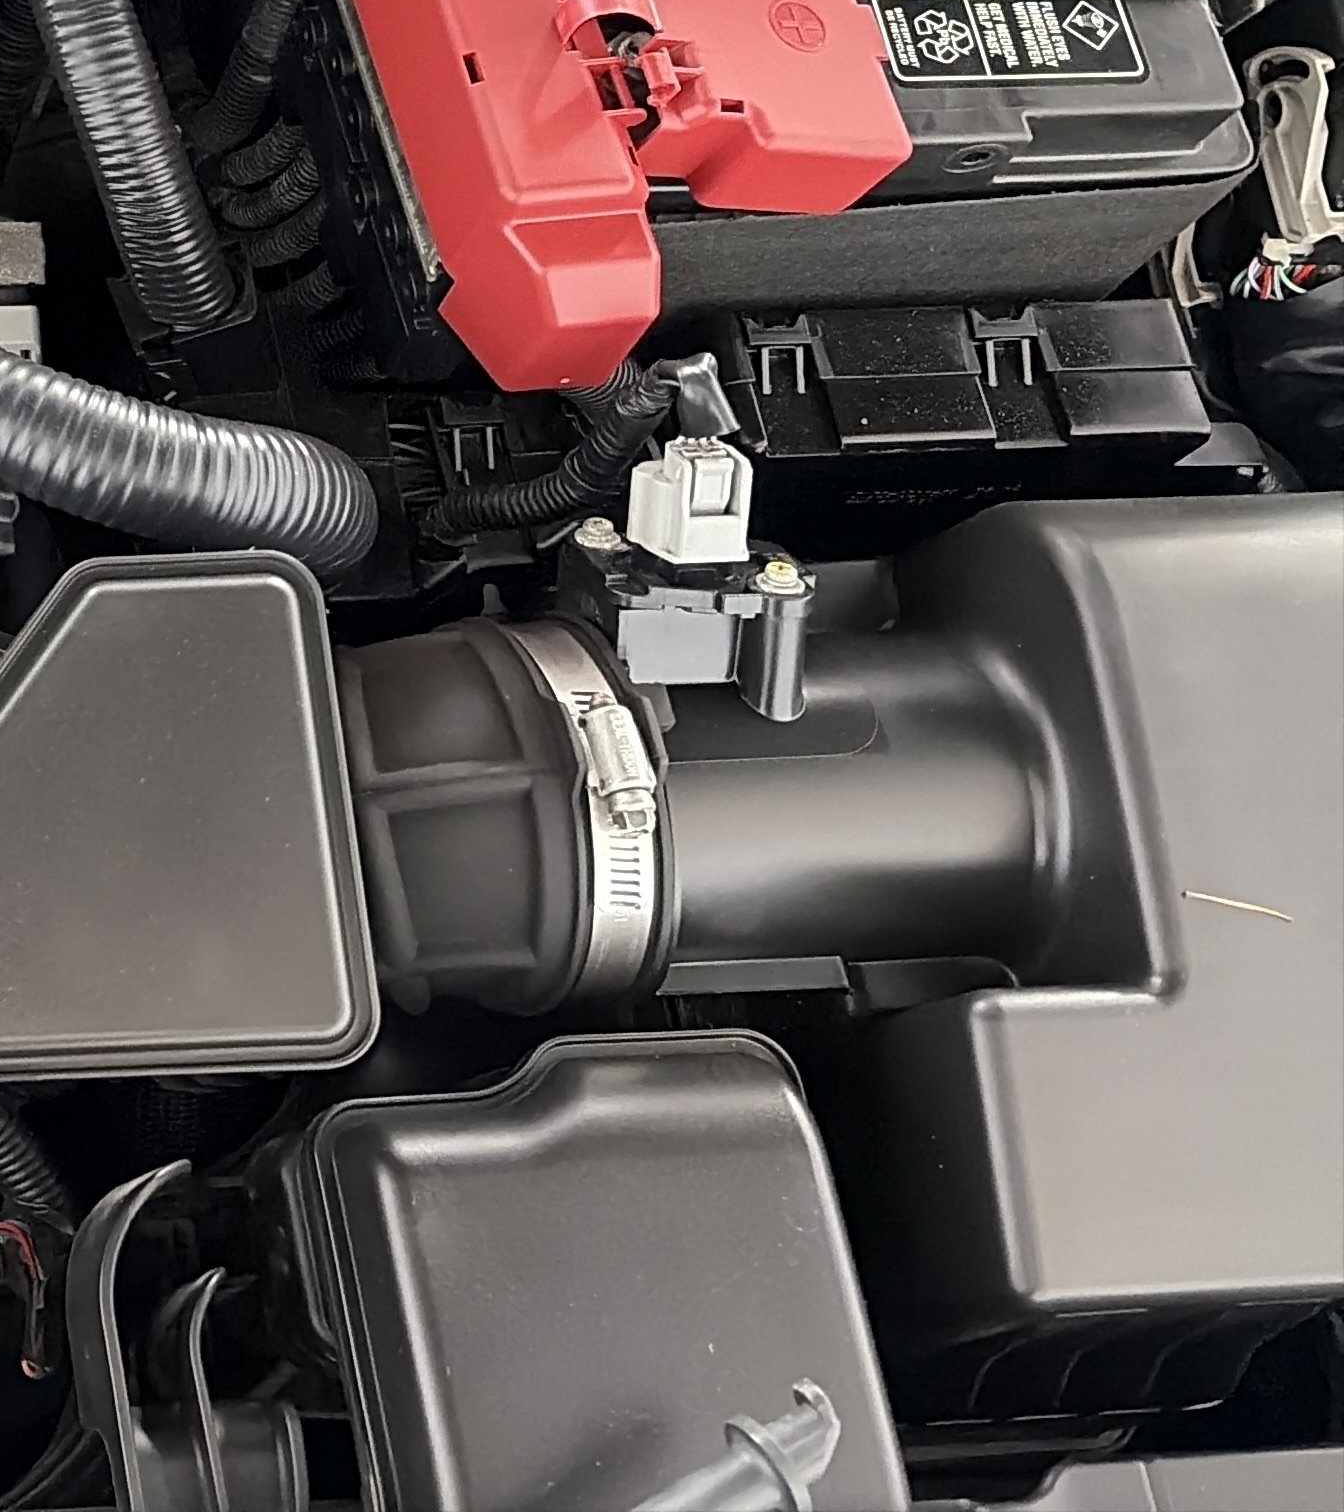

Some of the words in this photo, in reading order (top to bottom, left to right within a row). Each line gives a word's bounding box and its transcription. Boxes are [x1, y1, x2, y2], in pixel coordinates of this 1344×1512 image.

[883, 9, 895, 21] BE
[972, 2, 993, 28] HELP
[986, 2, 1005, 21] GET
[1010, 1, 1031, 27] WITH
[887, 22, 910, 66] RECYCLED
[892, 7, 913, 43] BATTERY
[904, 44, 921, 68] MUST
[935, 29, 952, 45] Pb
[981, 30, 1002, 57] FAST.
[993, 23, 1021, 68] MEDICAL
[1024, 1, 1059, 67] IMMEDIATELY
[1038, 1, 1061, 33] FLUSH
[1050, 35, 1071, 60] EYES
[1019, 29, 1044, 67] WATER.
